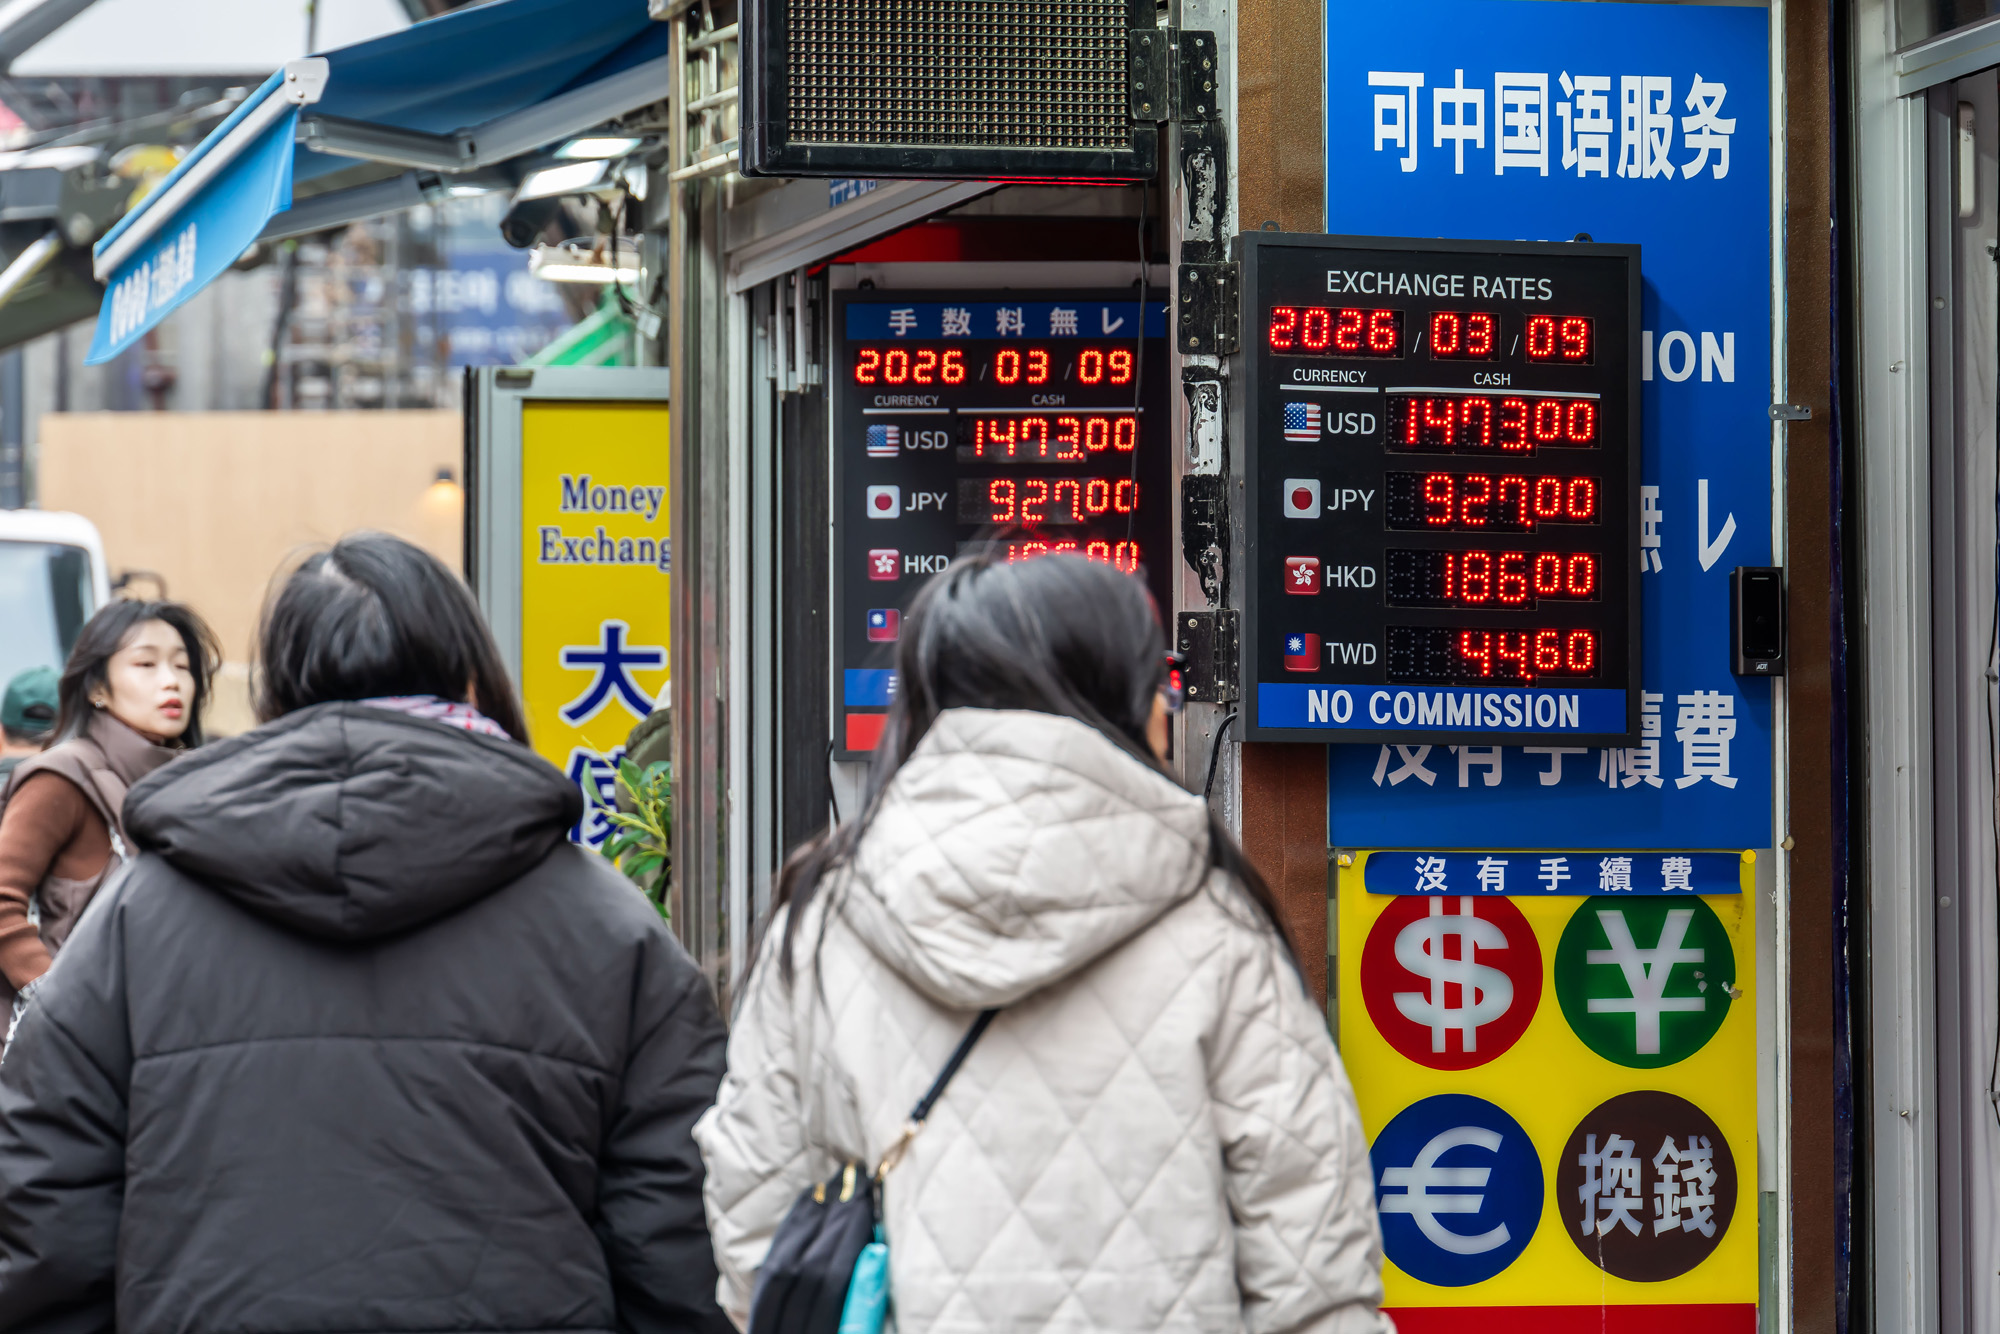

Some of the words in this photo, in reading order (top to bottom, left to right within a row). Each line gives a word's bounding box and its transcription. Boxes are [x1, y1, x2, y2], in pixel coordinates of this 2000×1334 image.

[1368, 68, 1737, 181] 可中国语服务
[1327, 270, 1465, 298] EXCHANGE
[1472, 276, 1553, 301] RATES
[1293, 368, 1367, 384] CURRENCY
[1473, 372, 1512, 387] CASH
[874, 394, 940, 407] CURRENCY
[1031, 393, 1066, 407] CASH
[1326, 412, 1377, 436] USD
[904, 430, 949, 450] USD
[560, 474, 666, 521] Money
[905, 491, 948, 512] JPY
[1327, 488, 1375, 512] JPY
[904, 554, 950, 574] HKD
[1326, 566, 1377, 589] HKD
[1326, 642, 1377, 666] TWD
[1308, 688, 1354, 724] NO
[1369, 690, 1580, 729] COMMISSION
[1414, 855, 1695, 893] 沒有手續費
[1578, 1132, 1719, 1239] 換錢
